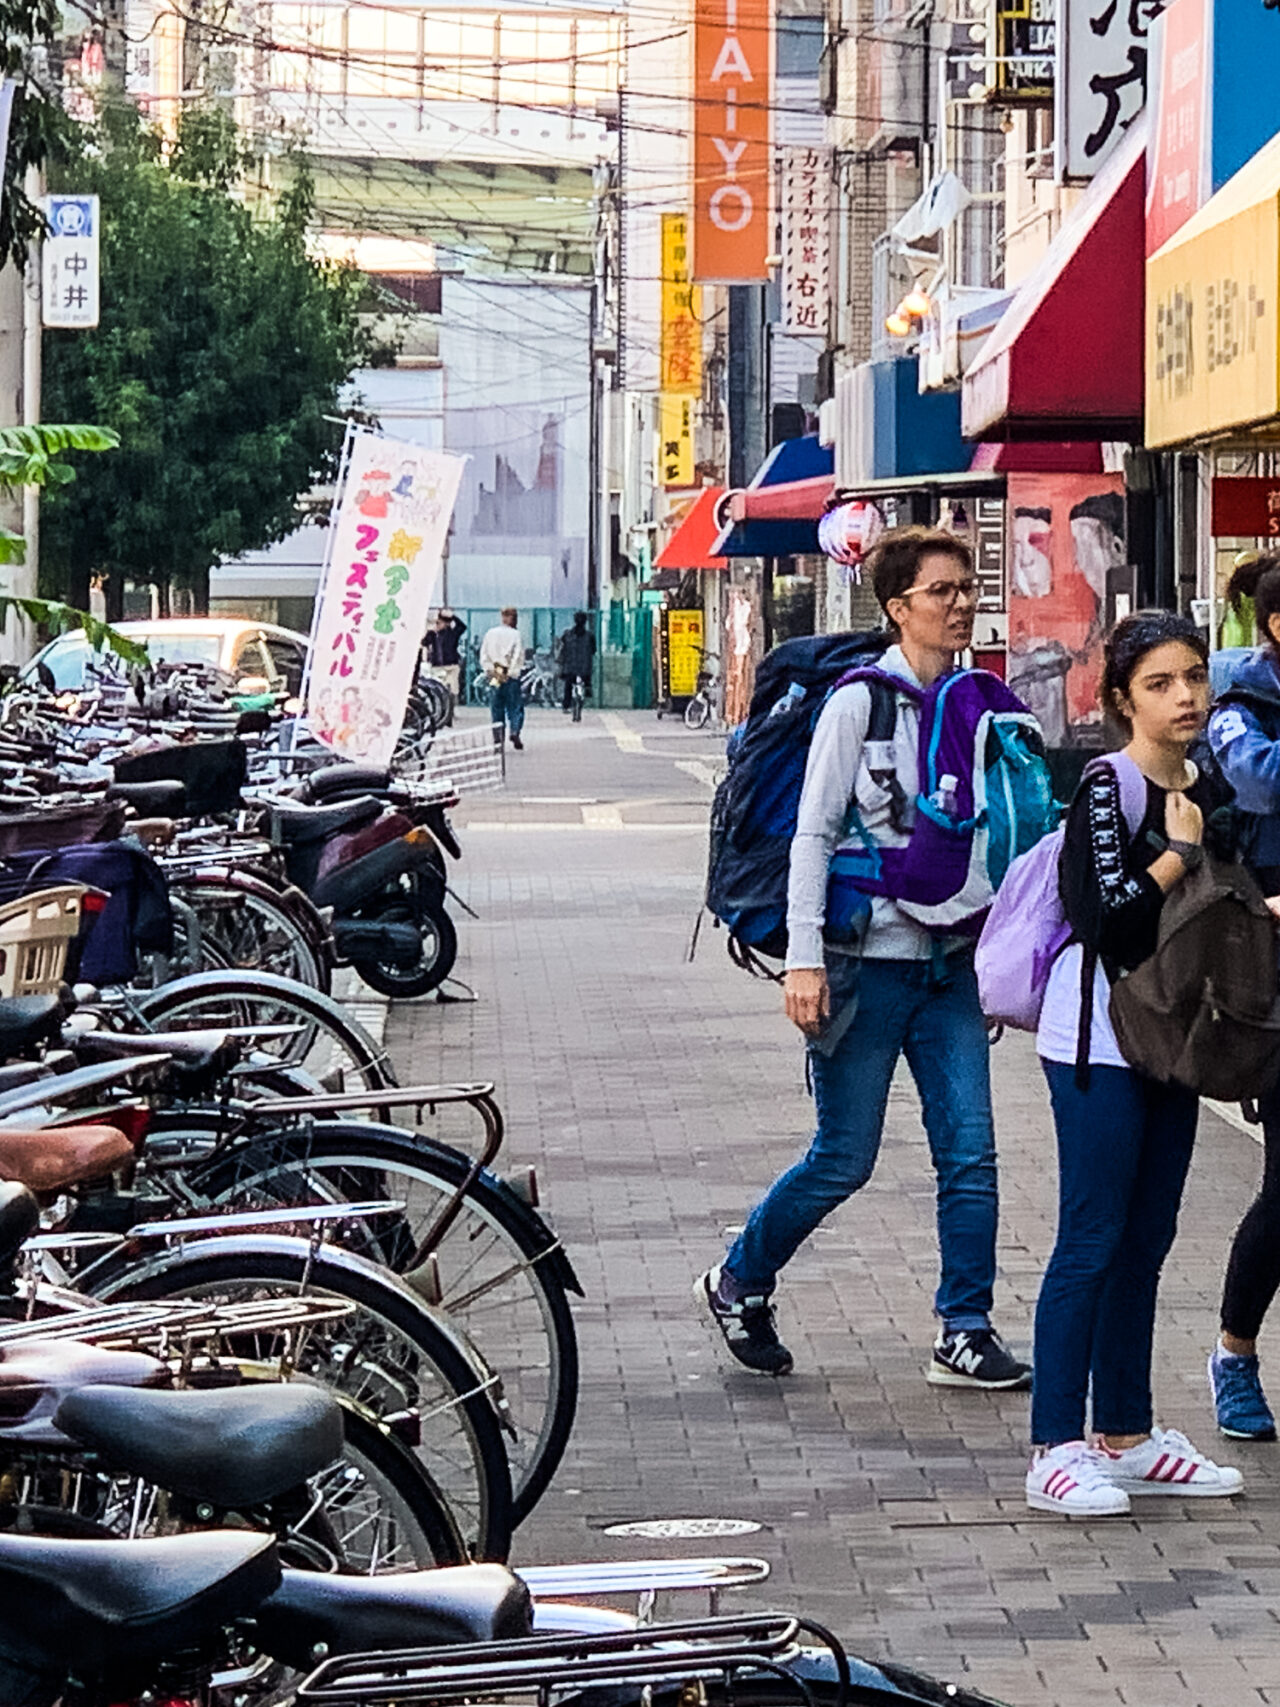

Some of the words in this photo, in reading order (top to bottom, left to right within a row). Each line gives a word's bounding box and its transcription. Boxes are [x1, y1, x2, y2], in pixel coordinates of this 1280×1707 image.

[800, 149, 818, 264] カラオケ喫茶
[64, 252, 88, 309] 中井
[797, 273, 818, 328] 右近
[329, 523, 380, 678] フェスティバル
